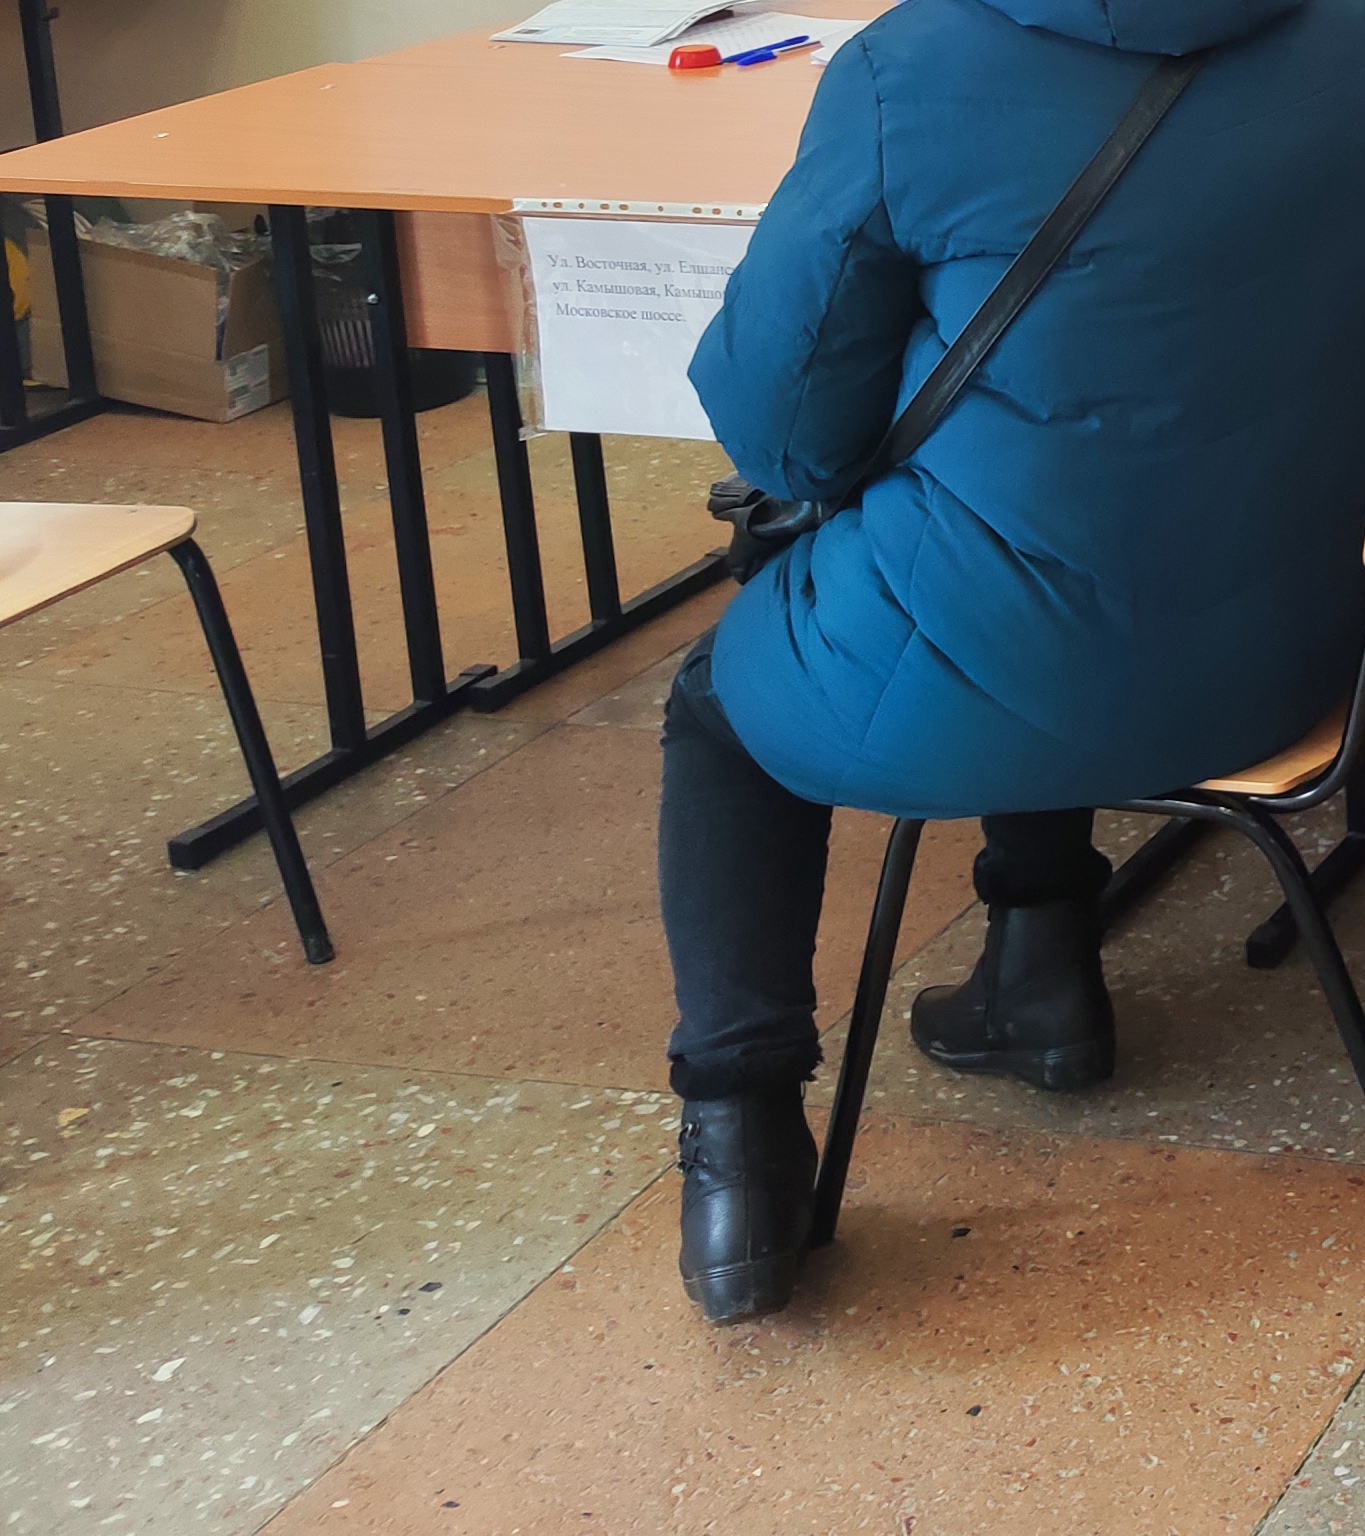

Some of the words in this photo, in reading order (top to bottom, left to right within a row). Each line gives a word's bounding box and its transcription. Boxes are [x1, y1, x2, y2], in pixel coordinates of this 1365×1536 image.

[548, 254, 572, 268] Ул.
[575, 256, 651, 272] Восточная,
[655, 261, 675, 275] ул.
[678, 260, 735, 276] Елшанс
[552, 281, 572, 295] ул.
[576, 279, 661, 298] Камышовая,
[664, 283, 725, 300] Камышо
[556, 302, 637, 319] Московское
